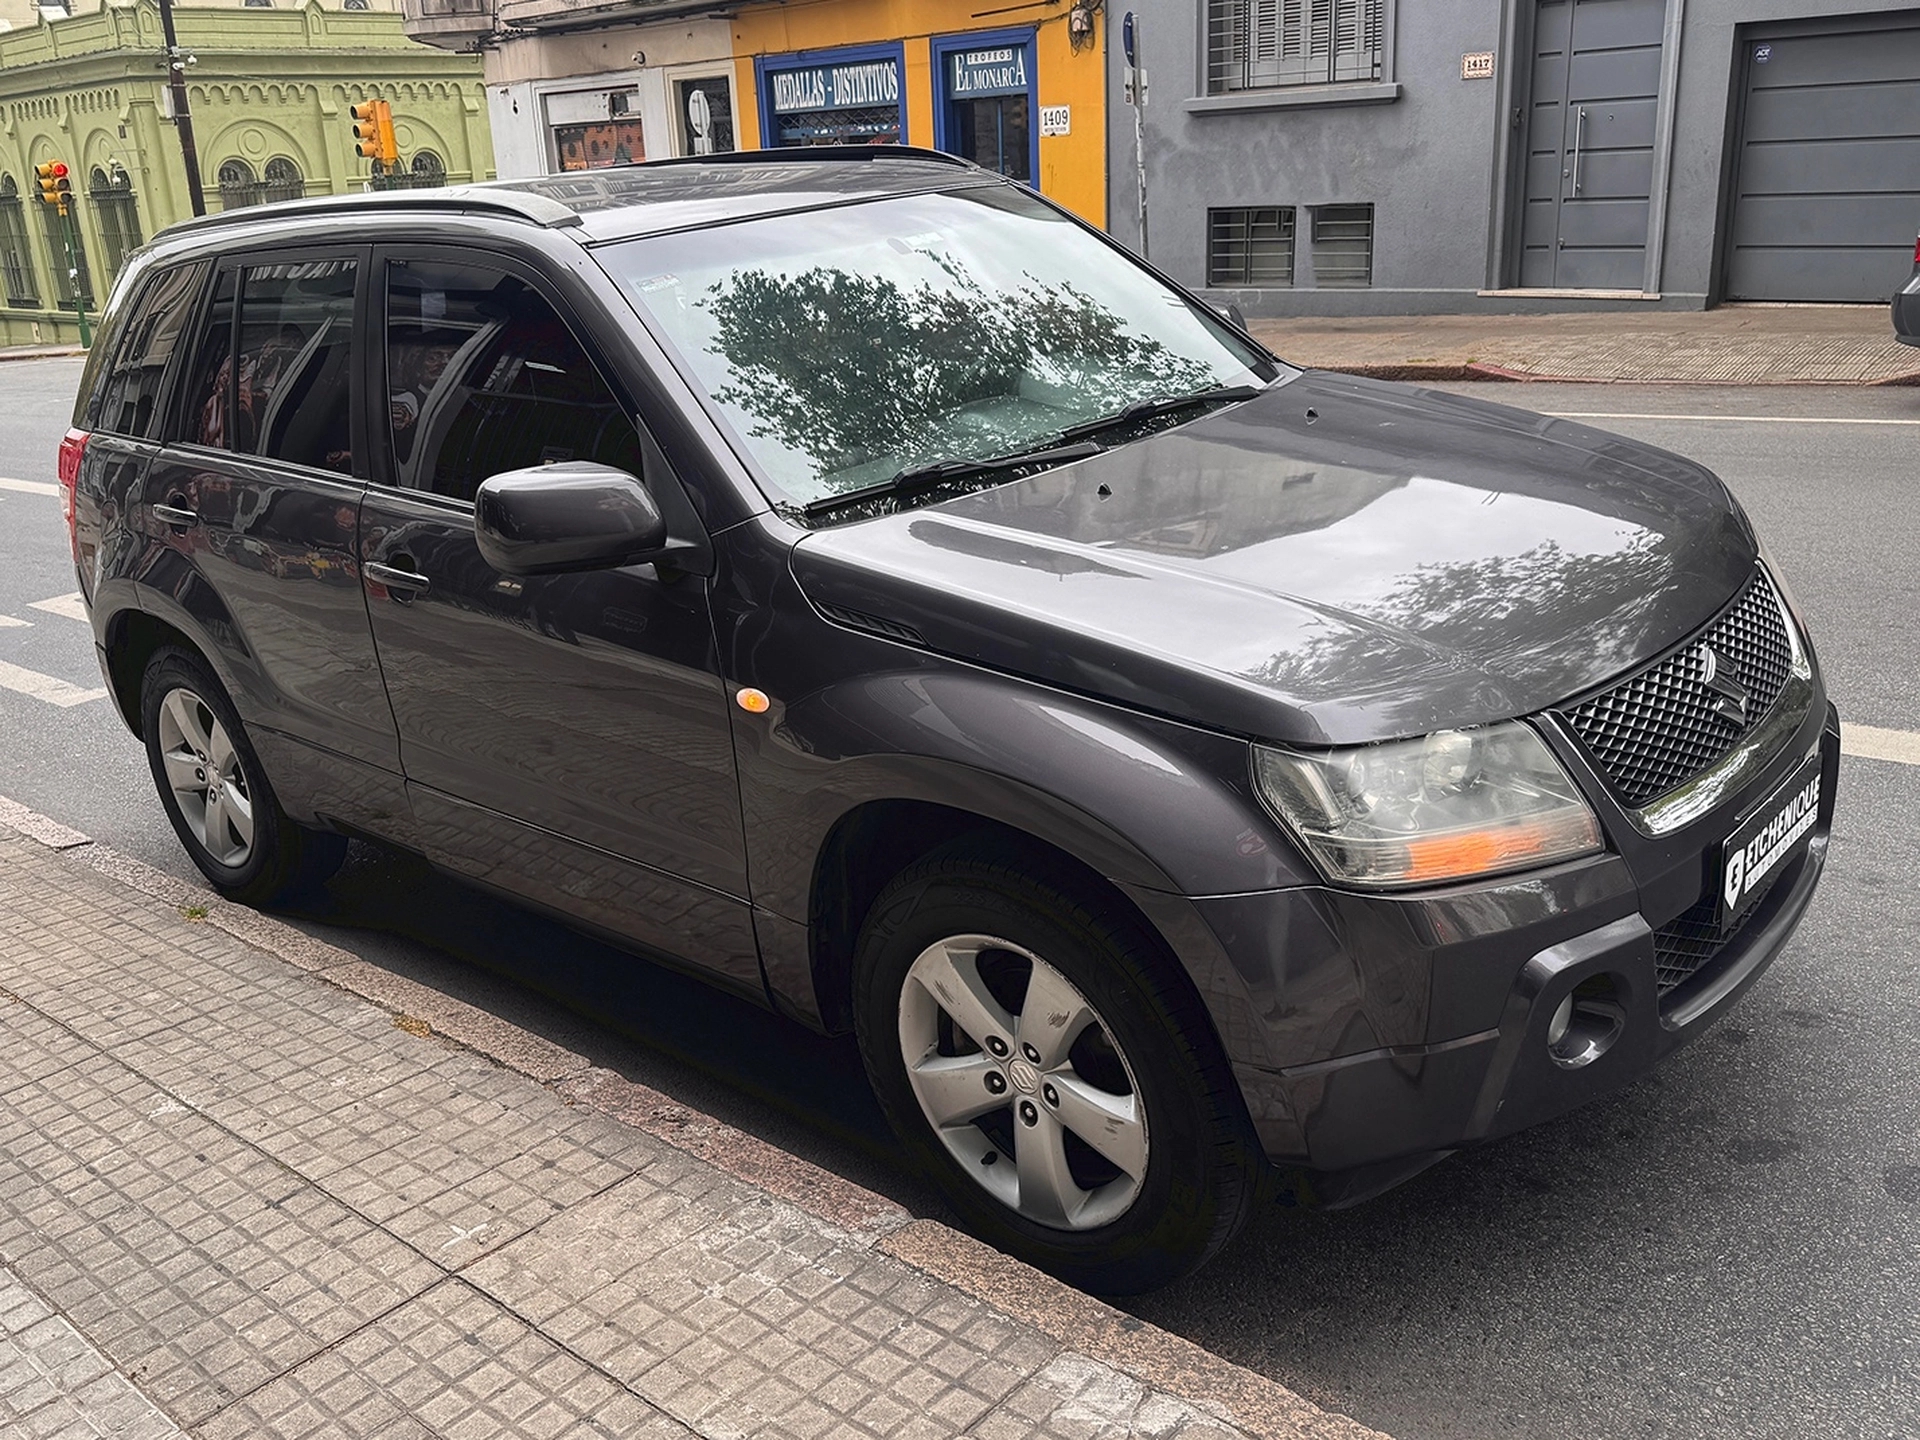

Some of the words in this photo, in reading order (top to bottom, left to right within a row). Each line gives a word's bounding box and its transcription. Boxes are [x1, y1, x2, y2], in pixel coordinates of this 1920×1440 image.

[968, 50, 1012, 63] TROFEOS
[973, 48, 1027, 90] MONARCA
[1467, 59, 1490, 68] 1417
[773, 69, 825, 110] MEDALLAS
[831, 61, 898, 105] DISTINTIVOS
[1043, 110, 1069, 126] 1409
[1745, 773, 1821, 872] ETCHENIQUE
